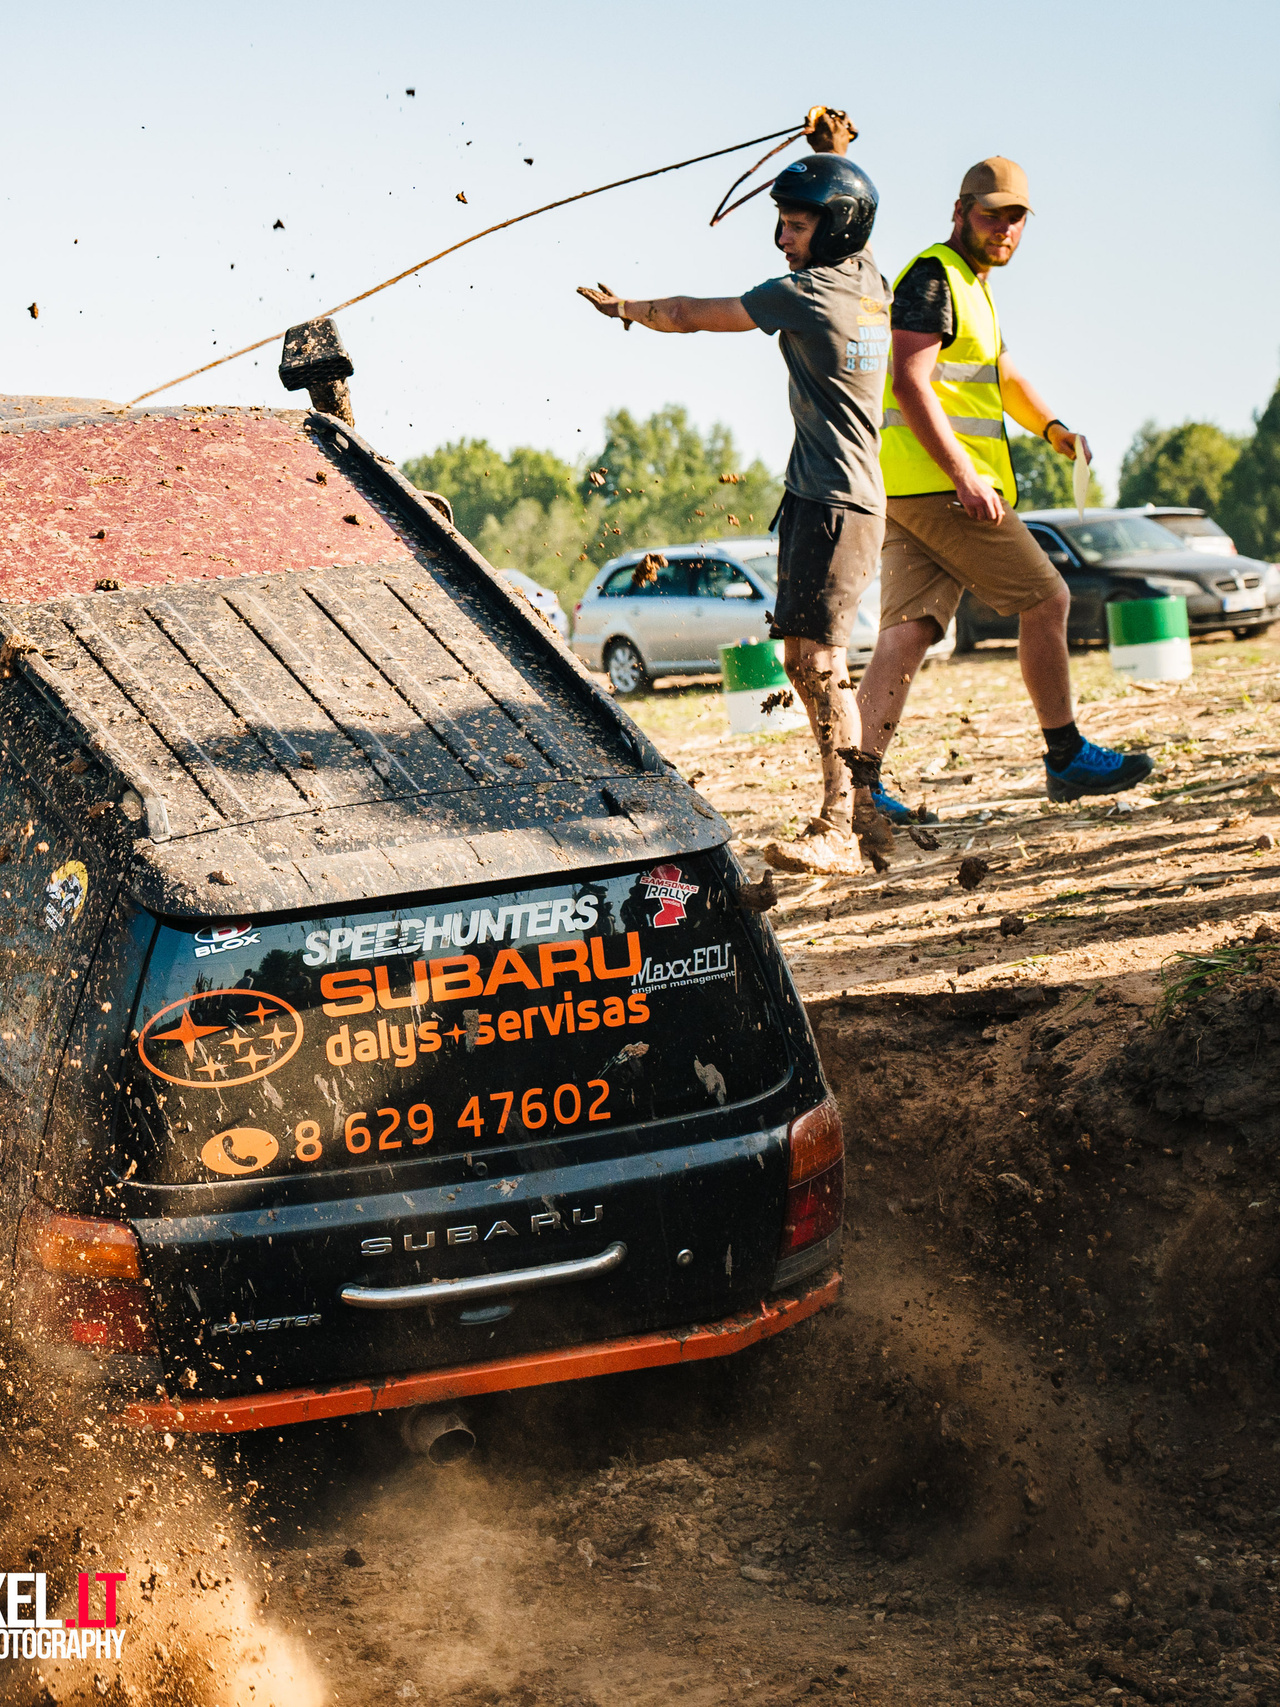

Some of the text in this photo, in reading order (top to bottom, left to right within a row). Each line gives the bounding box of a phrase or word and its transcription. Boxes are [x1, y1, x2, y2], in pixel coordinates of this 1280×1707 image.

[641, 876, 698, 893] SAMSONAS
[647, 885, 690, 902] RALLY
[194, 931, 261, 958] BLOX
[302, 894, 600, 967] SPEEDHUNTERS
[320, 931, 643, 1018] SUBARU
[631, 969, 737, 995] engine management
[325, 991, 651, 1069] dalys servisas
[294, 1078, 612, 1162] 8 629 47602
[360, 1204, 604, 1257] SUBARU
[210, 1313, 322, 1337] FORESTER
